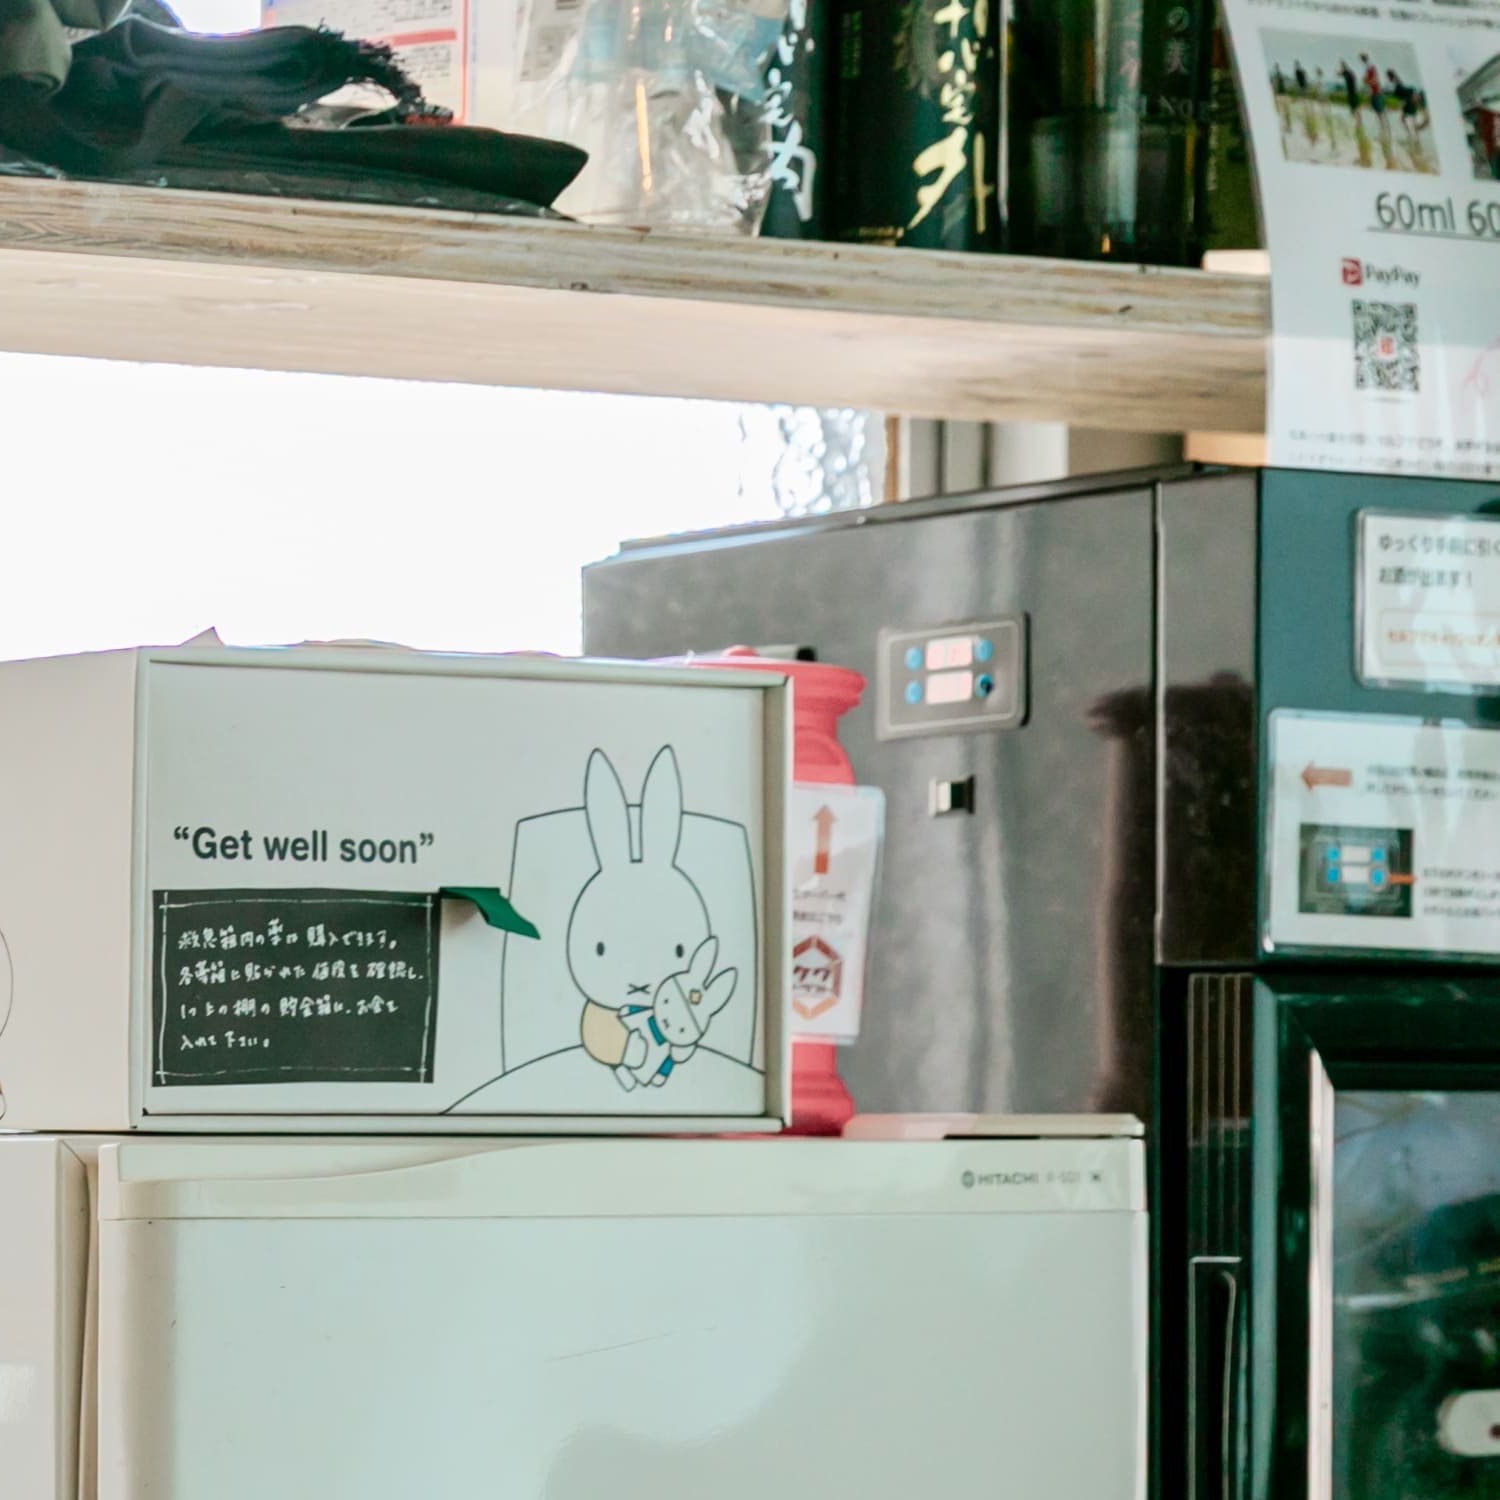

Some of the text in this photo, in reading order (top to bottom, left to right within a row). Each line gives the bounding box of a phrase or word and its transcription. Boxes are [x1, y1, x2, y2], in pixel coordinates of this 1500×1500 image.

[1375, 191, 1456, 230] 60ml
[1365, 264, 1420, 289] PayPay
[263, 829, 328, 861] well
[977, 1171, 1040, 1186] HITACHI
